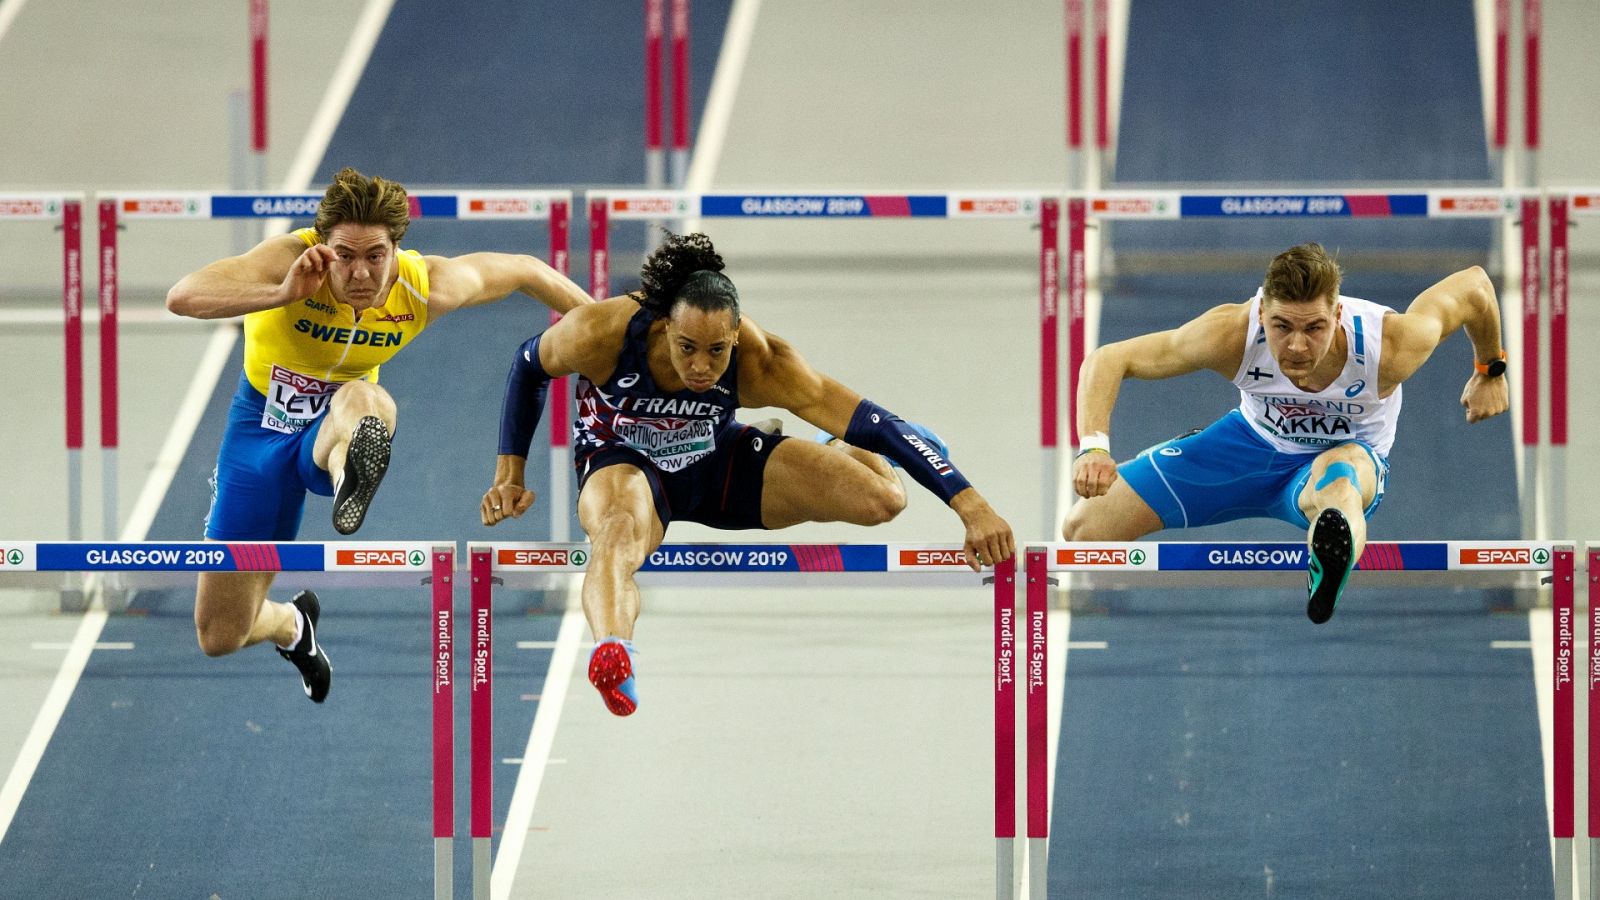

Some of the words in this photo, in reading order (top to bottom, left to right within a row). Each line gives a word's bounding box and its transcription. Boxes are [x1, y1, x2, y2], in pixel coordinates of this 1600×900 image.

[252, 198, 320, 214] GLASGO
[741, 197, 826, 214] GLASGOW
[1220, 197, 1306, 214] GLASGOW
[294, 318, 403, 347] SWEDEN
[632, 398, 724, 416] FRANCE
[660, 443, 692, 456] CLEAN
[903, 434, 948, 471] FRANCE
[86, 550, 181, 565] GLASGOW
[185, 550, 225, 565] 2019
[353, 552, 406, 564] SPAR
[515, 551, 568, 564] SPAR
[650, 551, 744, 565] GLASGOW
[748, 551, 788, 565] 2019
[1074, 551, 1126, 563] SPAR
[1208, 550, 1304, 565] GLASGOW
[1477, 550, 1529, 563] SPAR
[436, 651, 450, 686] Sport
[475, 649, 488, 684] Sport
[999, 649, 1012, 684] Sport
[1030, 652, 1044, 686] Sport
[1556, 648, 1571, 683] Sport
